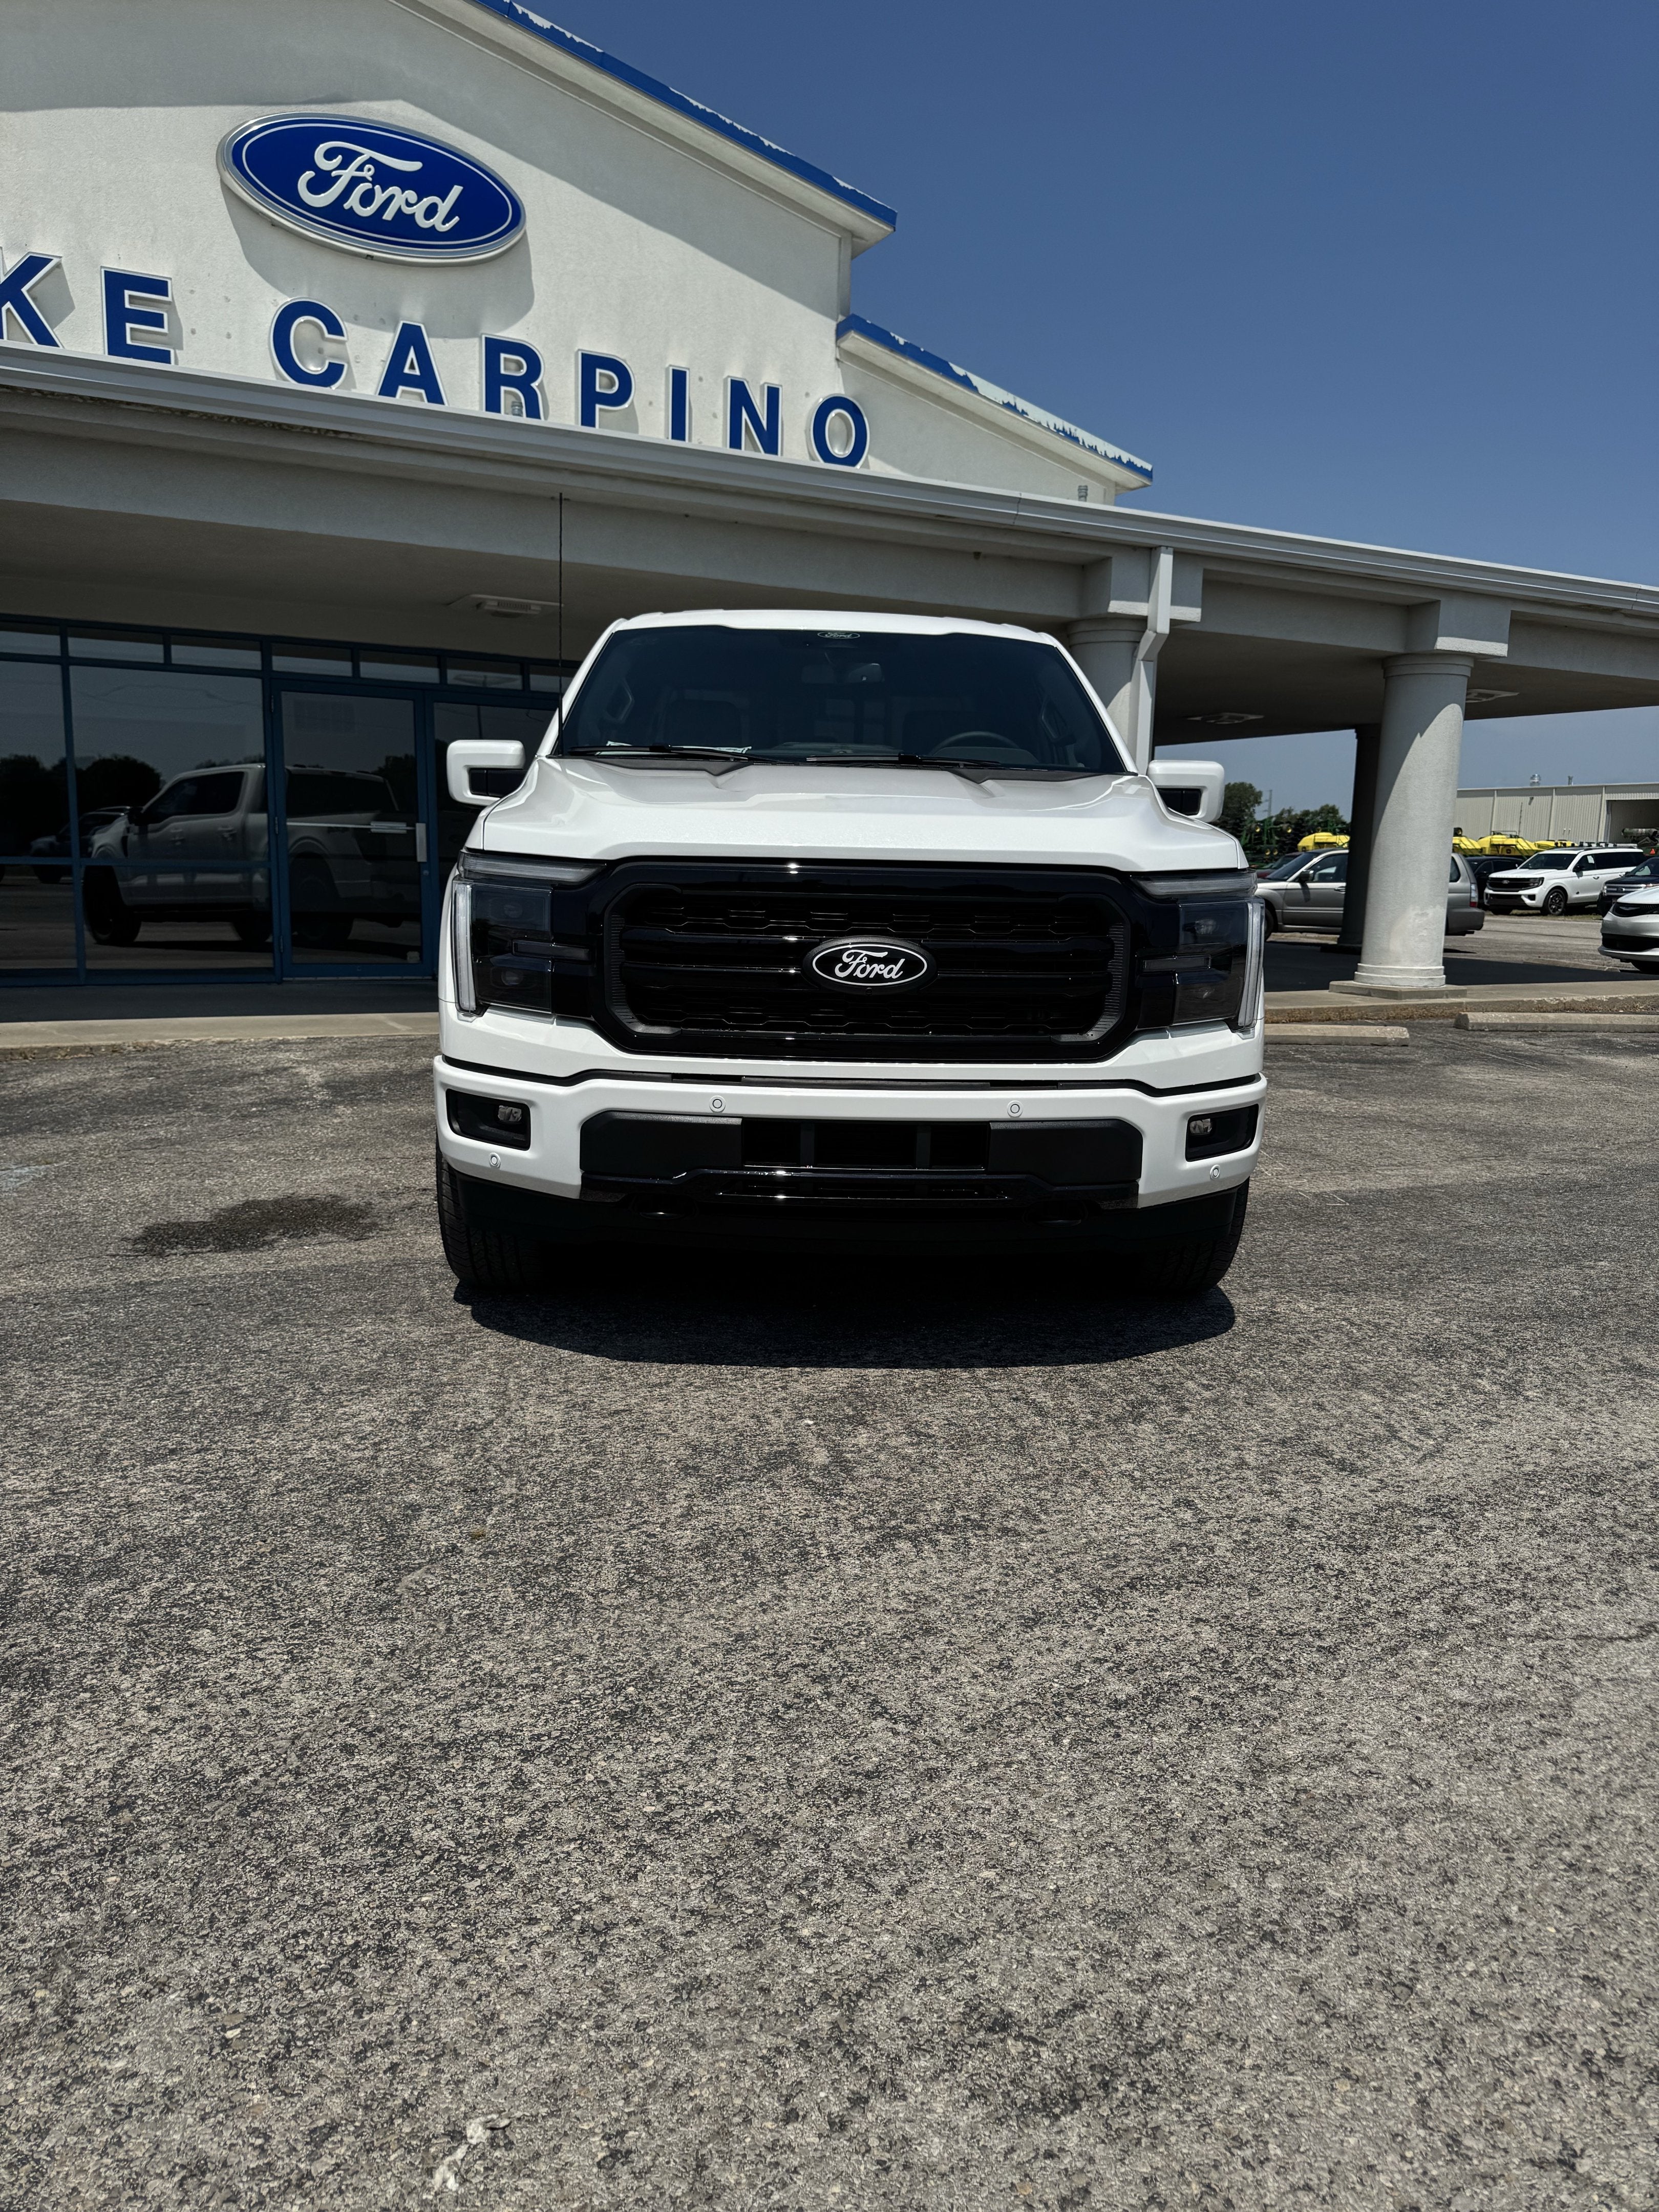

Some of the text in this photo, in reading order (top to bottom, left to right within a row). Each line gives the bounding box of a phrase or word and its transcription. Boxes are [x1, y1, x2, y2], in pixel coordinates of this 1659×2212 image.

[298, 141, 463, 231] Ford
[270, 296, 869, 469] CARPINO
[835, 949, 905, 979] Ford
